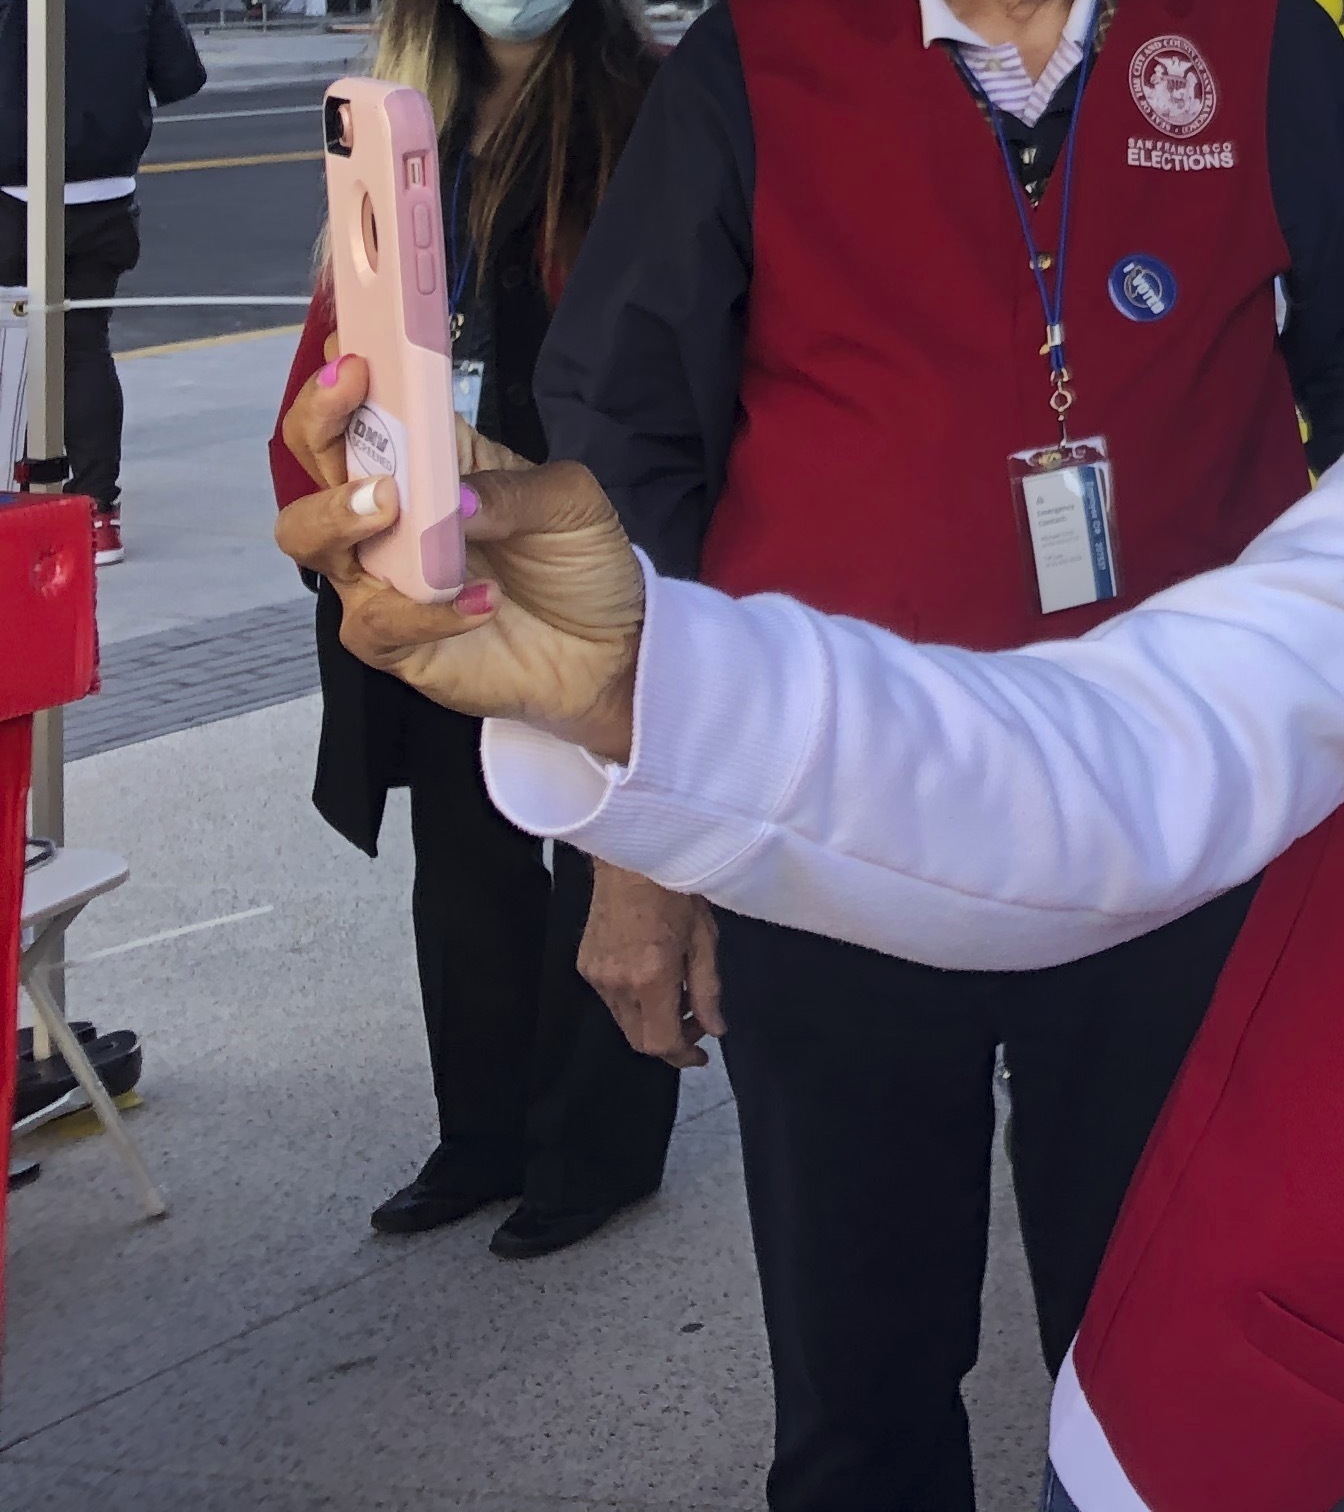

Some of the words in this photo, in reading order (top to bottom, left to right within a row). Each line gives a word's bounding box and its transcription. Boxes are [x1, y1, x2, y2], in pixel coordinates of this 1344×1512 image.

[1127, 137, 1153, 150] SAN
[1156, 140, 1232, 156] FRANCISCO
[1127, 147, 1234, 172] ELECTIONS
[1132, 273, 1165, 315] VOTED
[353, 418, 389, 453] DMV
